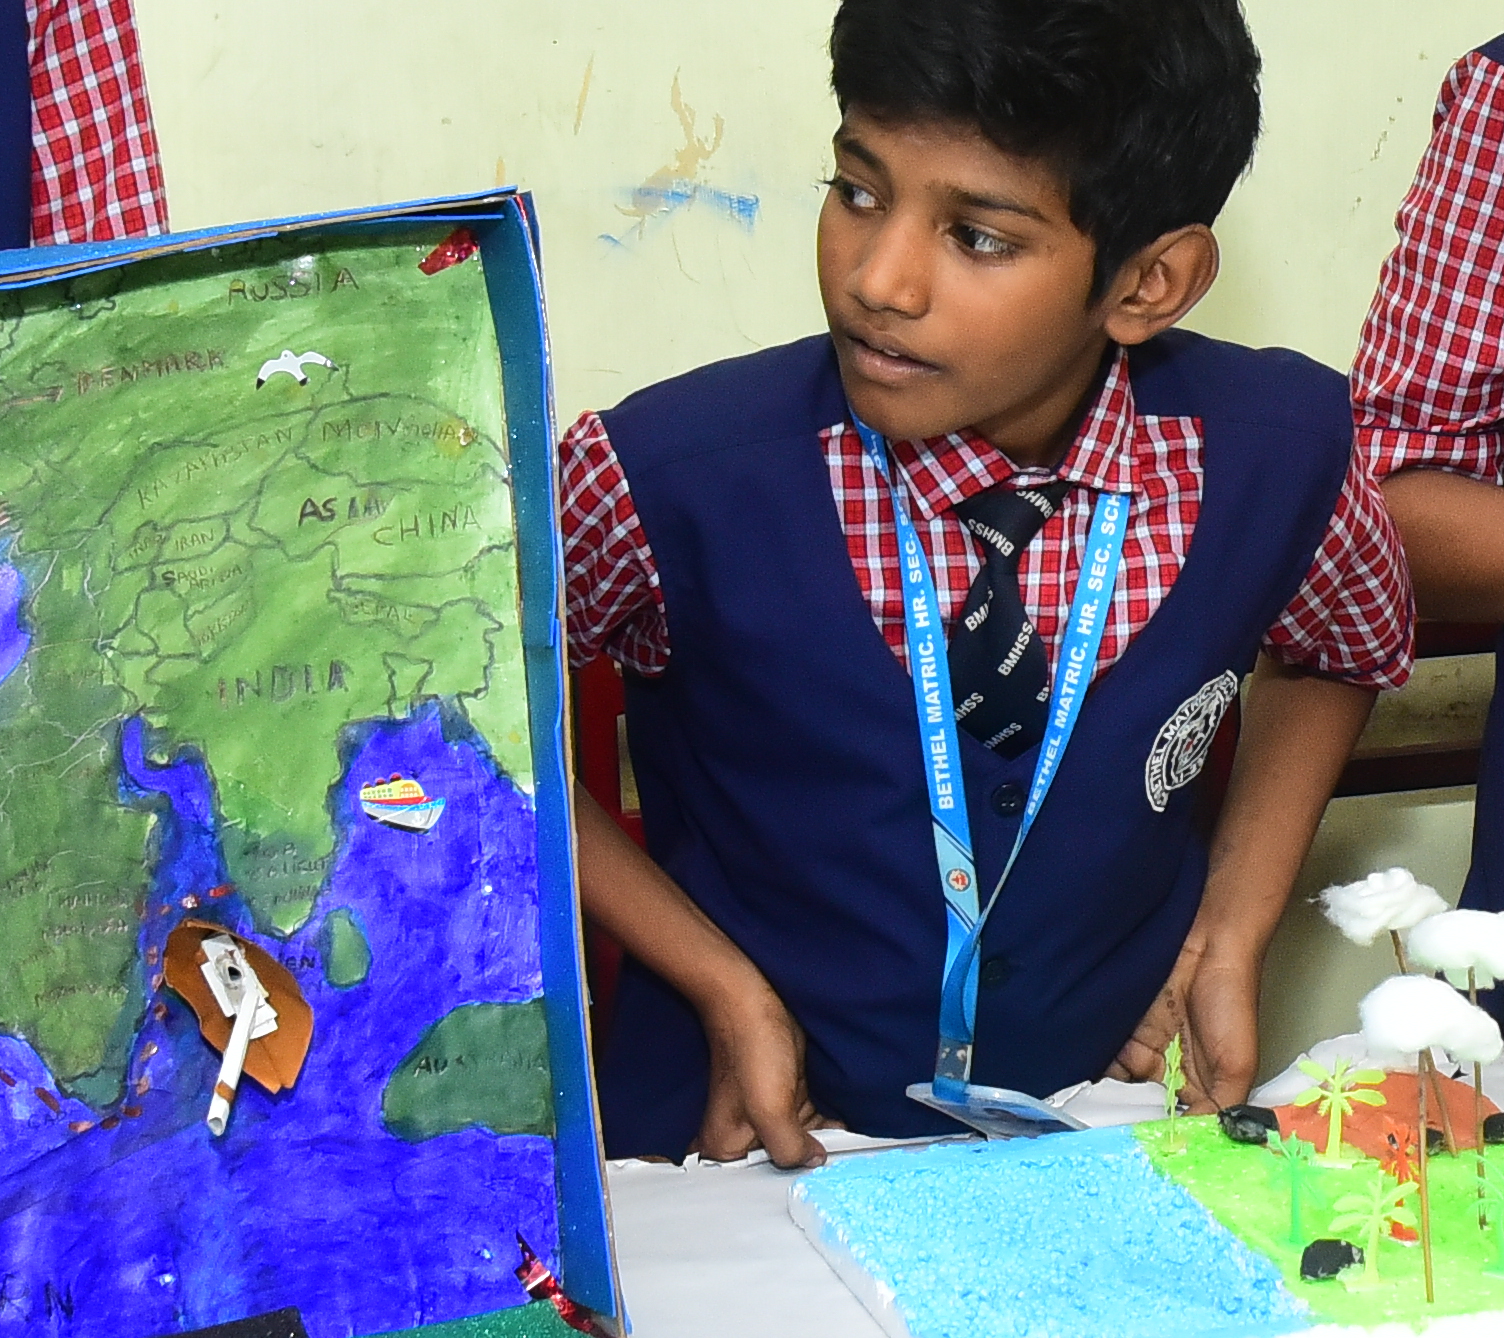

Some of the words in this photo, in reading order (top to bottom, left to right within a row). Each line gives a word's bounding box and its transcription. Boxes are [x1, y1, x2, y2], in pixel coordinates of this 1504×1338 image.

[372, 506, 483, 547] CHINA
[912, 589, 930, 628] HR.
[997, 621, 1034, 677] BMHSS
[216, 662, 351, 706] INDIA
[920, 633, 947, 724] MATRIC.
[1027, 734, 1062, 816] BETHEL
[1054, 639, 1088, 729] MATRIC.
[1076, 597, 1099, 635] HR.
[1088, 542, 1112, 592] SEC.
[930, 728, 954, 810] BETHEL
